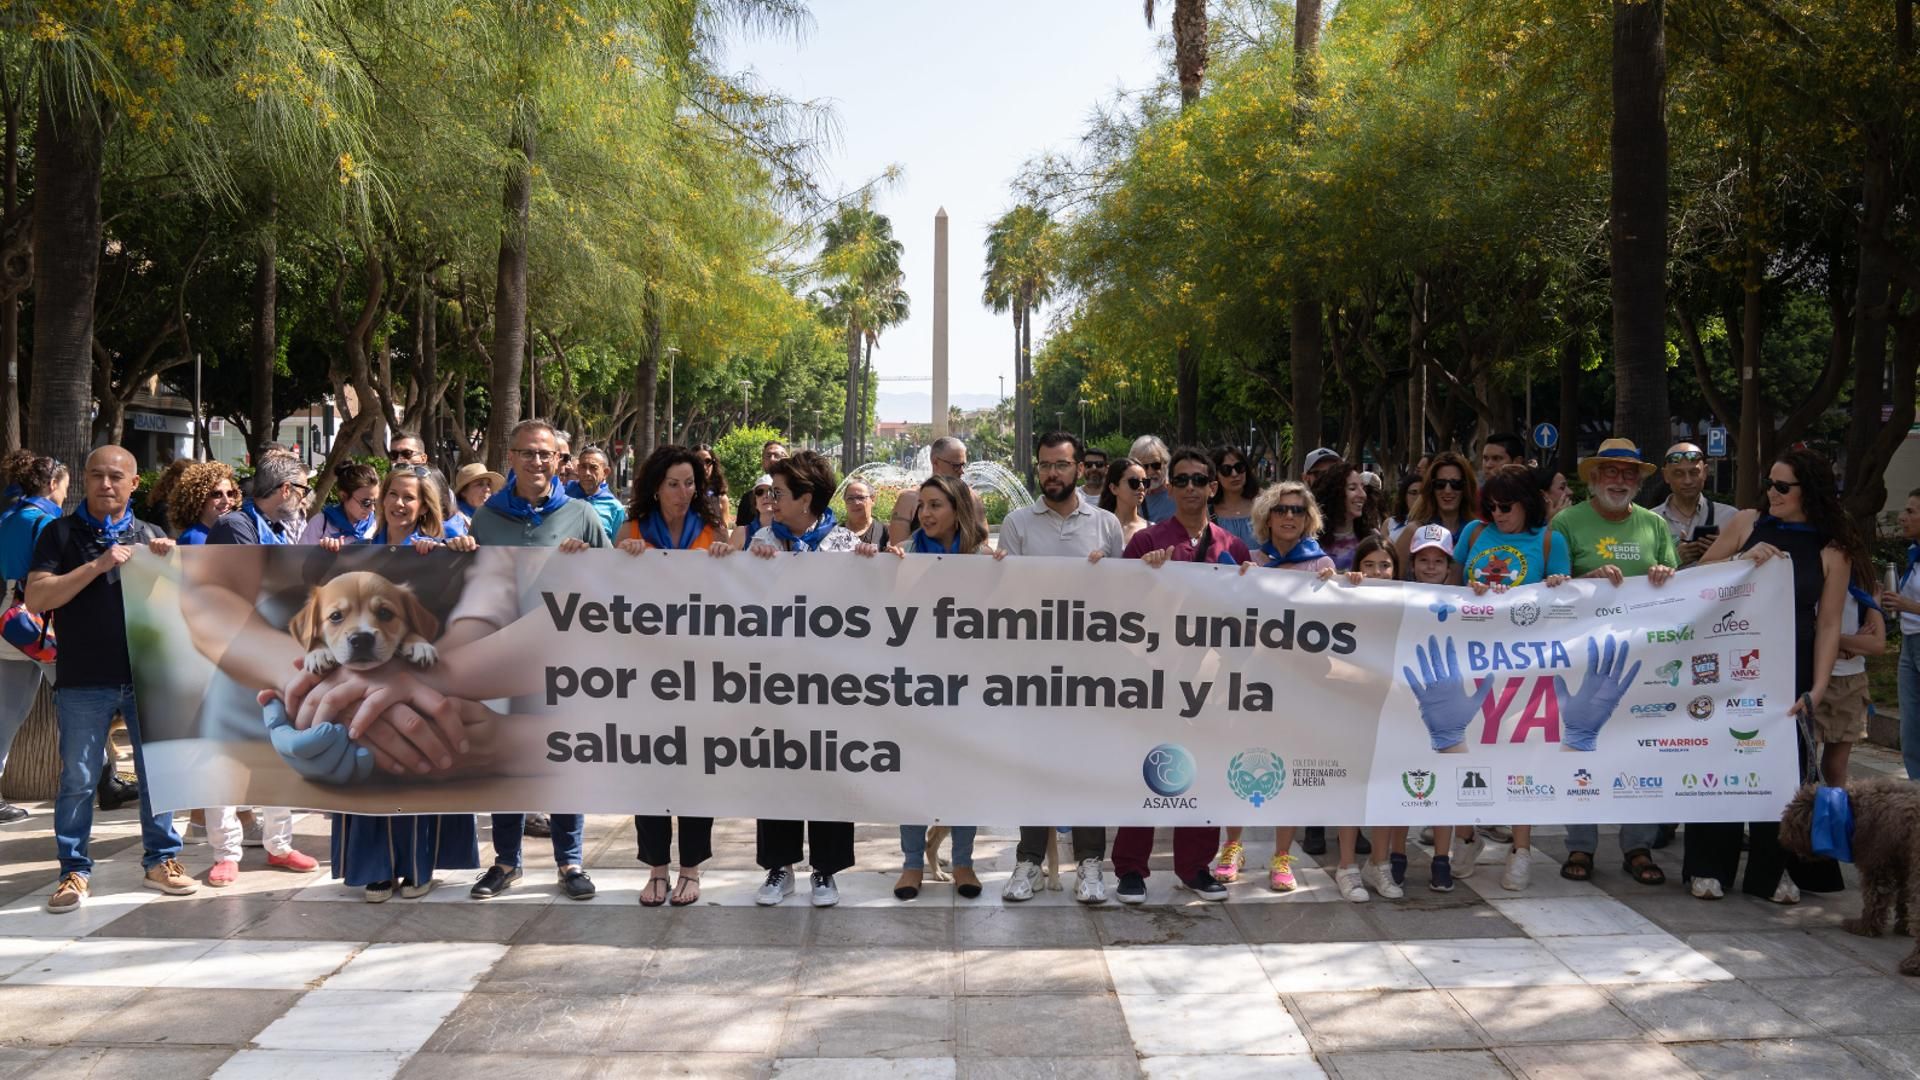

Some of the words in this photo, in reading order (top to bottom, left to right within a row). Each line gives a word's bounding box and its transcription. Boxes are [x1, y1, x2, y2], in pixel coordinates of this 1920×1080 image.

[1607, 544, 1640, 553] VERDES
[1615, 553, 1641, 561] EQUO
[1461, 605, 1495, 616] ceve
[541, 592, 872, 638] Veterinarios
[885, 604, 918, 647] y
[933, 596, 1160, 653] familias,
[1175, 608, 1357, 655] unidos
[1467, 640, 1572, 671] BASTA
[545, 664, 637, 706] por
[650, 660, 696, 702] el
[712, 661, 969, 706] bienestar
[982, 666, 1164, 709] animal
[1178, 680, 1214, 719] y
[1227, 671, 1274, 712] la
[1726, 698, 1764, 708] AVEDE
[1474, 675, 1561, 745] YA
[1637, 738, 1709, 747] VETWARRIOS
[545, 723, 687, 767] salud
[704, 726, 901, 774] pública
[1292, 768, 1348, 777] VETERINARIOS
[1142, 797, 1198, 809] ASAVAC
